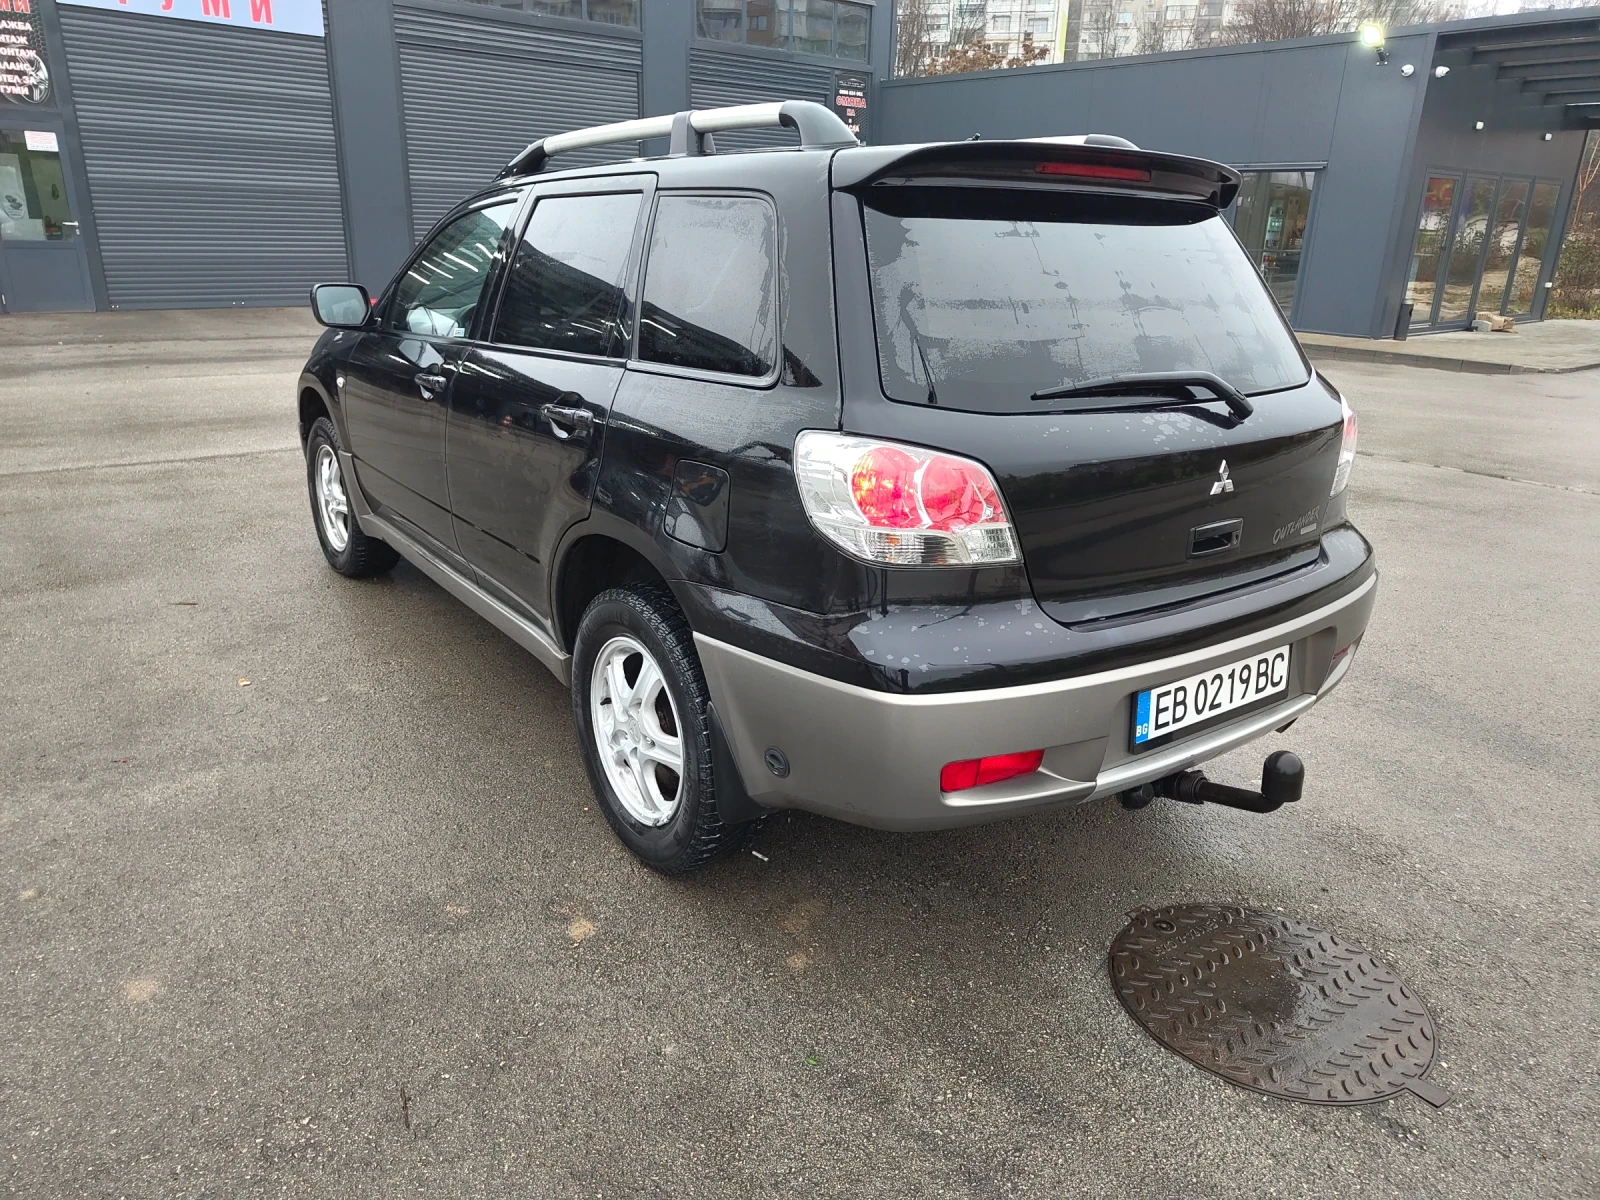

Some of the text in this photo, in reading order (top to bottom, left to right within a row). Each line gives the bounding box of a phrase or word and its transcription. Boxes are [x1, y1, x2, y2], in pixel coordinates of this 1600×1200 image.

[0, 74, 20, 84] ТЕЛ
[836, 96, 867, 108] СМЯНА
[1273, 504, 1320, 545] OUTLANDER
[1154, 652, 1285, 732] EB 0219 BC
[1136, 723, 1149, 737] BG
